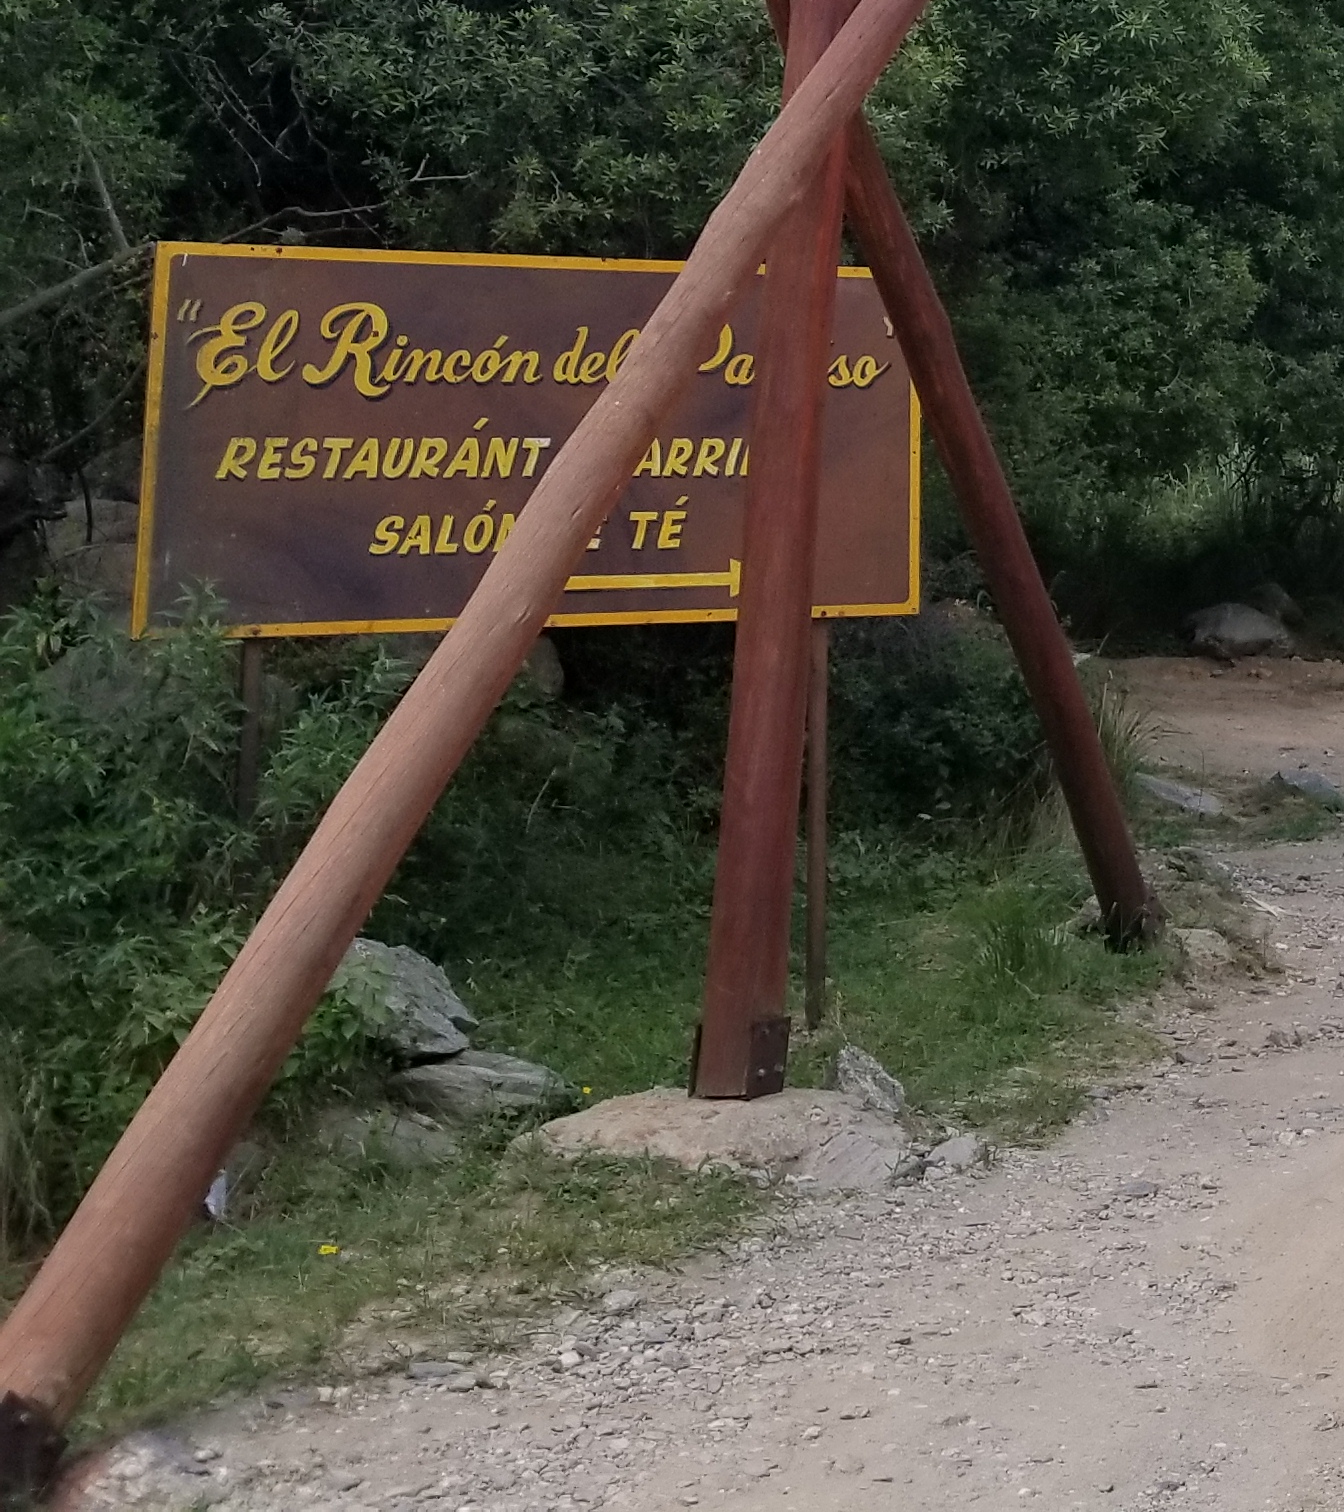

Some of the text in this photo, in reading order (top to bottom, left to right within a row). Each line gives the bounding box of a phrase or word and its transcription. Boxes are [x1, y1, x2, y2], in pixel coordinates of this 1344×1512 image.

[302, 301, 544, 398] Rincón
[214, 416, 552, 480] RESTAURÁNT
[628, 494, 690, 551] TÉ
